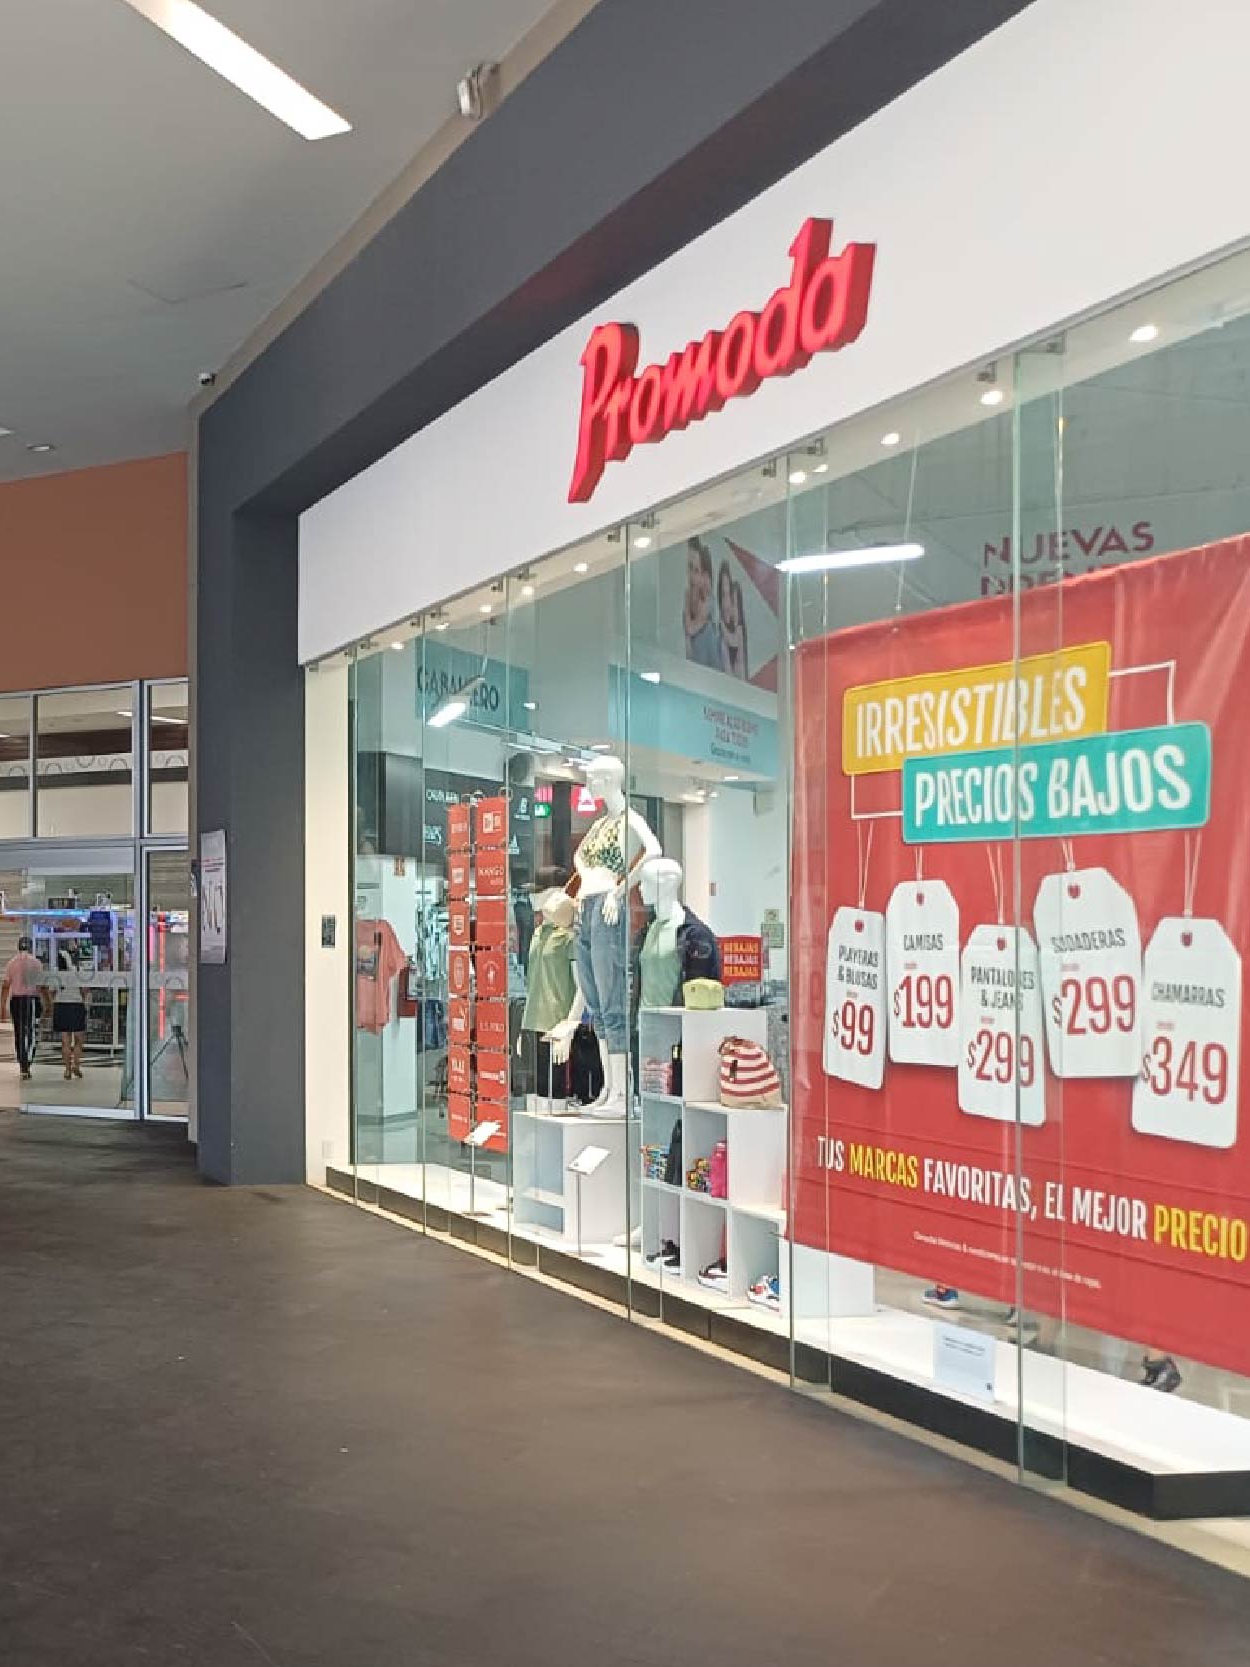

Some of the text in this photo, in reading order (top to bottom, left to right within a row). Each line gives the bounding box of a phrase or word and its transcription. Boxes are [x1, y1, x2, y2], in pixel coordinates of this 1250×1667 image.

[568, 217, 877, 503] Promoda
[983, 521, 1155, 567] NUEVAS
[417, 665, 499, 711] CABALERO
[855, 665, 1087, 757] IRRESISTIBLES
[914, 744, 1191, 827] PRECIOS BAJOS
[838, 945, 879, 968] PLAYERAS
[903, 934, 944, 951] CAMISAS
[846, 968, 878, 990] BLUSAS
[893, 974, 954, 1029] $199
[1053, 975, 1136, 1036] $299
[1152, 982, 1225, 1008] CHAMARRAS
[833, 1000, 874, 1056] $99
[966, 1028, 1035, 1087] $299
[1142, 1036, 1228, 1105] $349
[818, 1136, 845, 1172] TUS
[849, 1143, 919, 1188] MARCAS
[924, 1158, 1037, 1221] FAVORITAS,
[1044, 1181, 1066, 1221] EL
[1072, 1186, 1148, 1240] MEJOR
[1153, 1204, 1247, 1263] PRECIO
